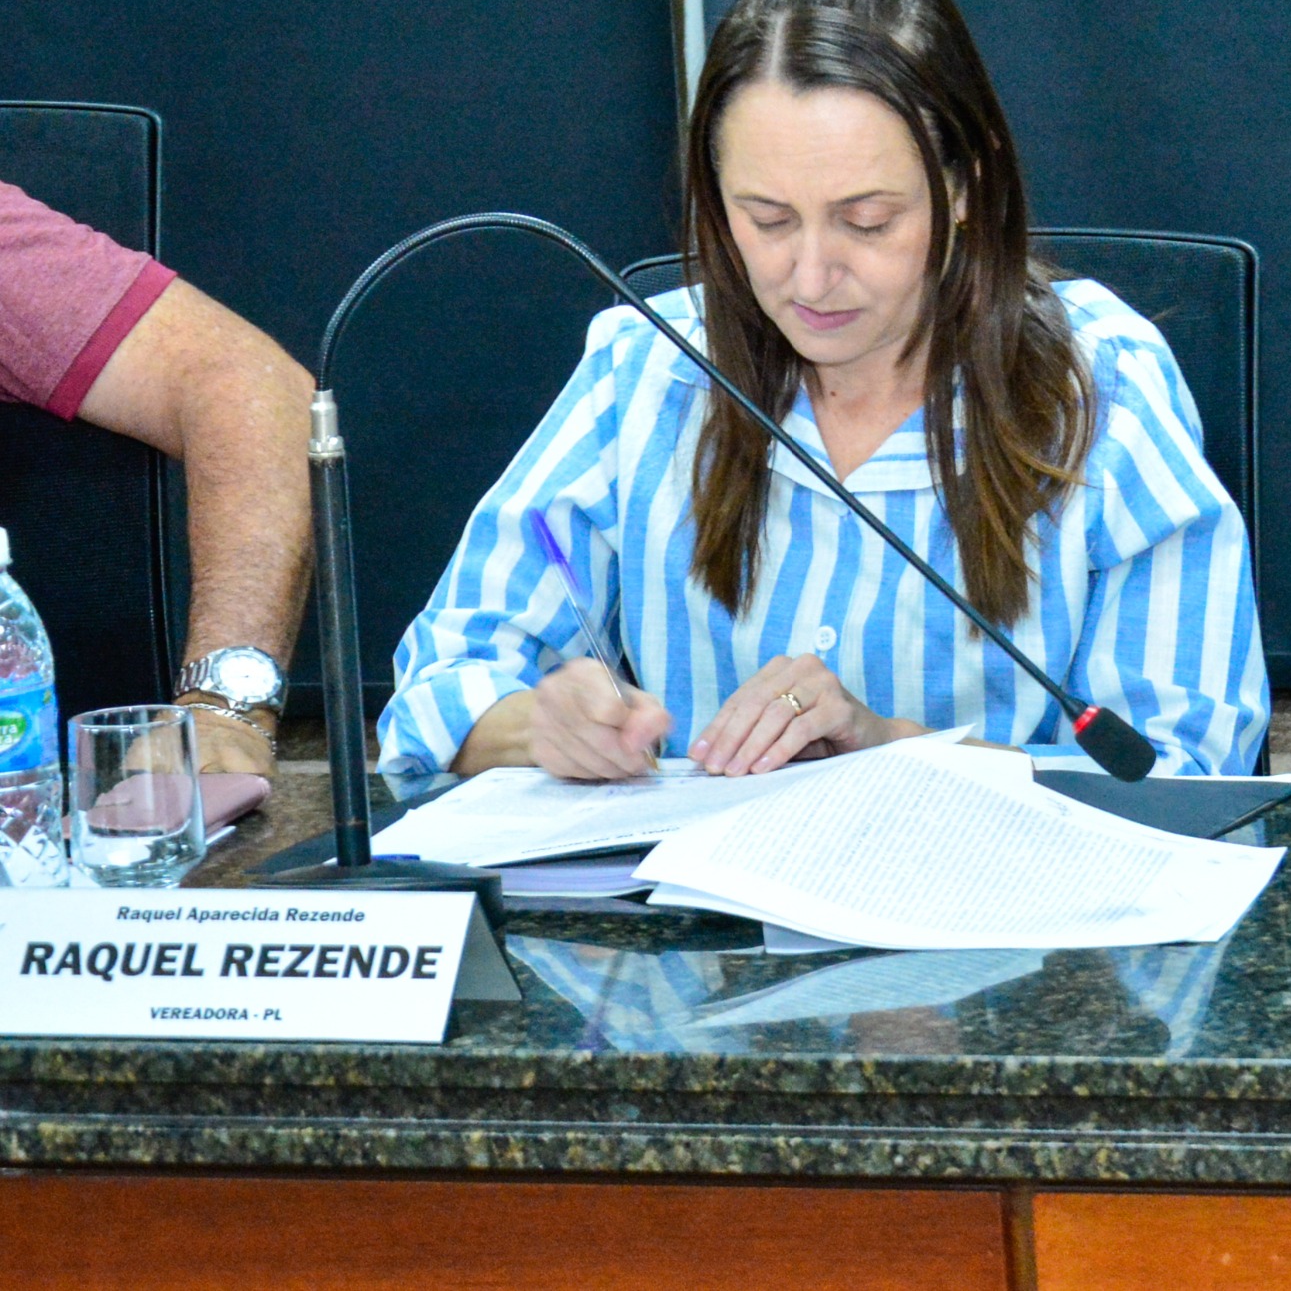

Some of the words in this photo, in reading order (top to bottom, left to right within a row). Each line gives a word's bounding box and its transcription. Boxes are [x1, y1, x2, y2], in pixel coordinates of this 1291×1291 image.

[116, 906, 182, 923] Raquel
[186, 907, 280, 924] Aparecida
[285, 908, 365, 923] Rezende
[20, 941, 204, 982] RAQUEL
[220, 943, 443, 980] REZENDE
[150, 1007, 249, 1021] VEREADORA
[262, 1009, 282, 1021] PL
